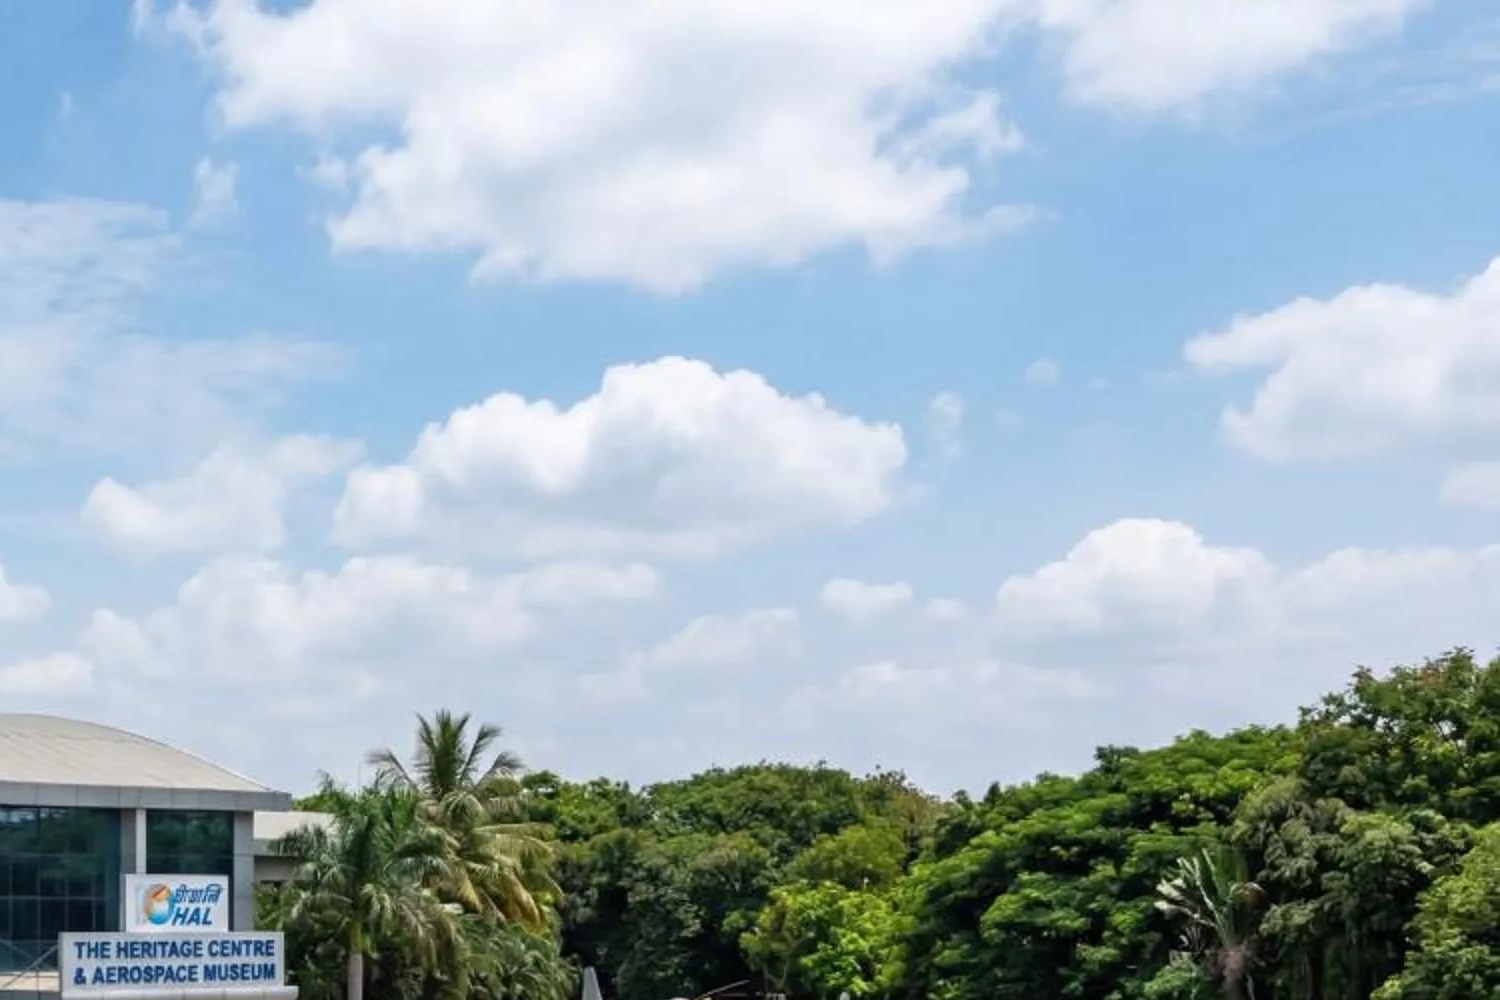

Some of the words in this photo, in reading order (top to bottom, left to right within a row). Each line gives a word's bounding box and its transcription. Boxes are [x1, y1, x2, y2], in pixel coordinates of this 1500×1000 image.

[172, 907, 213, 927] HAL
[73, 941, 111, 959] THE
[116, 940, 203, 959] HERITAGE
[208, 939, 275, 957] CENTRE
[73, 967, 87, 985] &
[92, 964, 199, 984] AEROSPACE
[203, 963, 276, 981] MUSEUM
